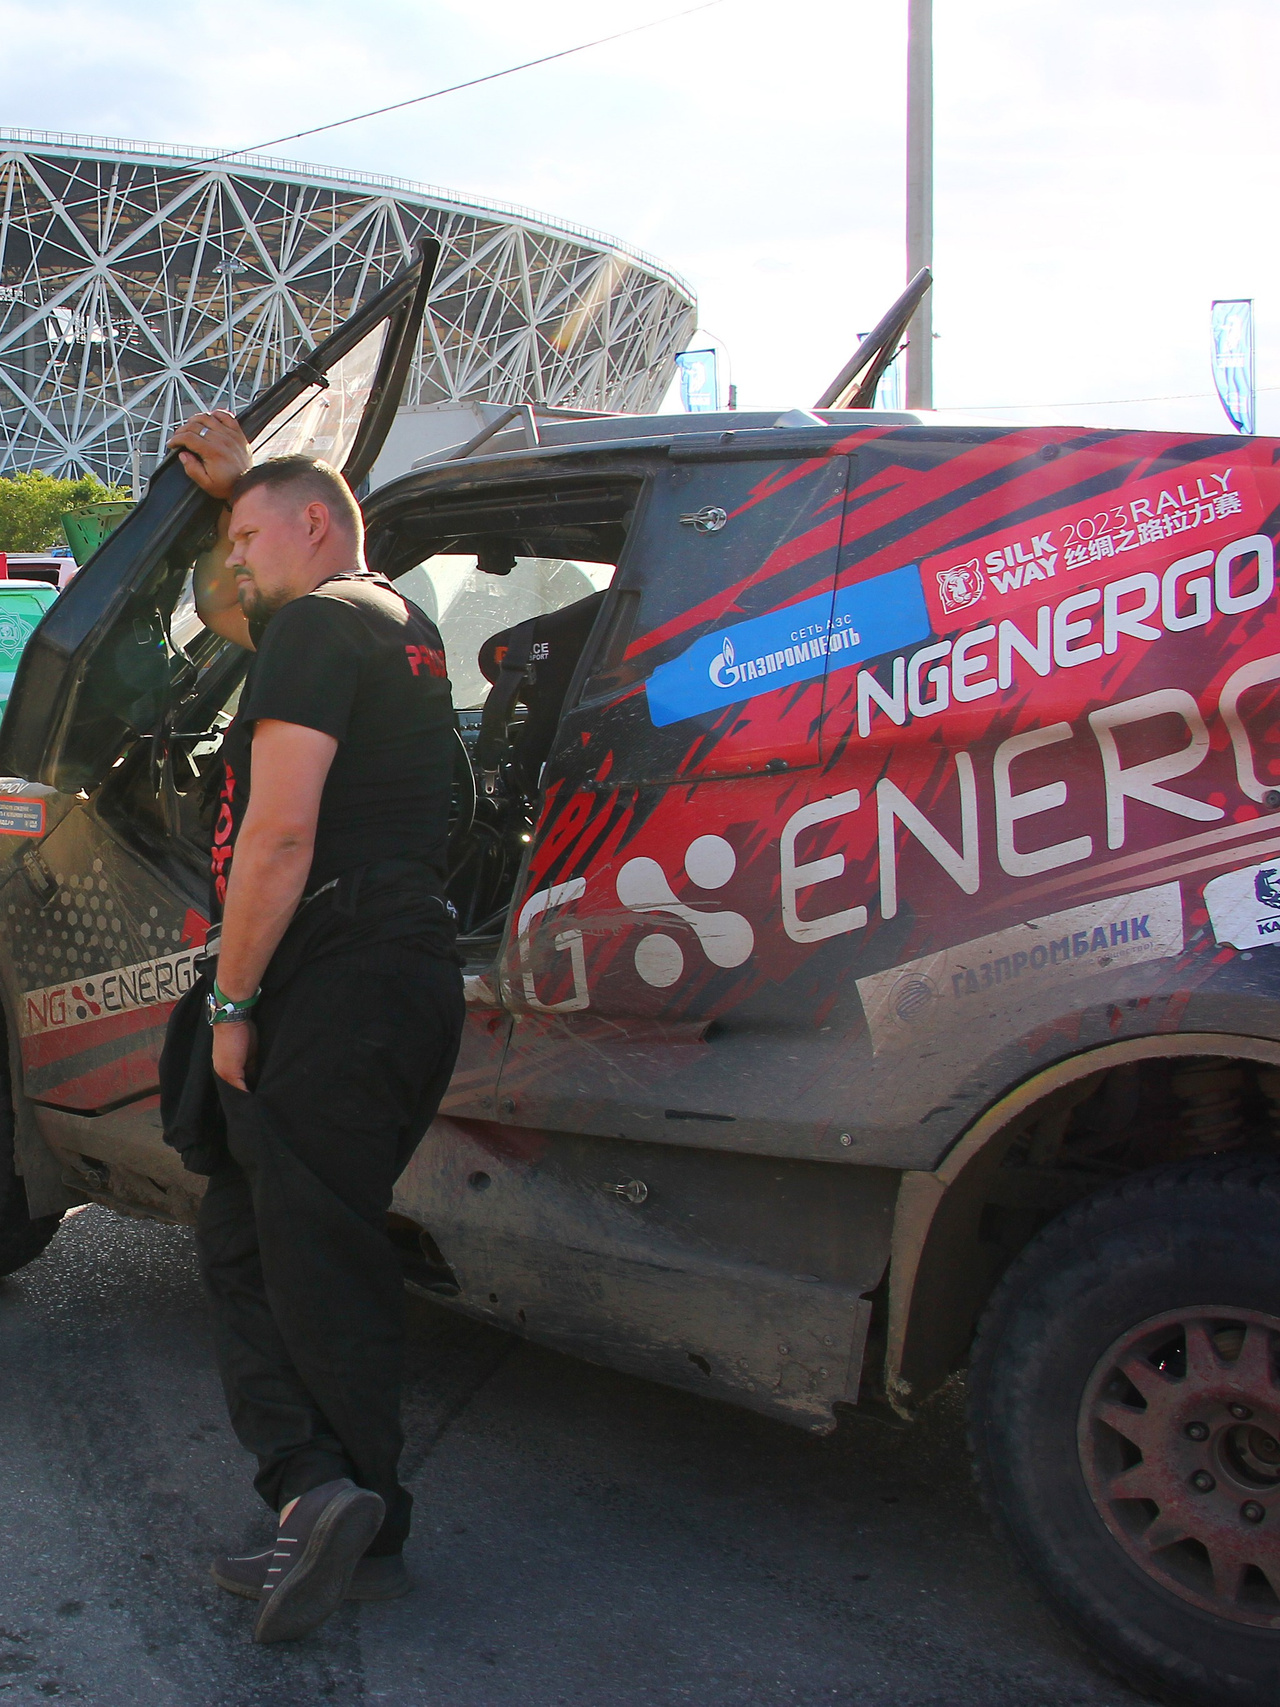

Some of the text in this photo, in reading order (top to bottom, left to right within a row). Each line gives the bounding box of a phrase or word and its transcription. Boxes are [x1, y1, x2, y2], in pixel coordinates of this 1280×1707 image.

[1060, 469, 1232, 547] 2023 RALLY
[1063, 490, 1242, 571] 丝绸之路拉力赛
[984, 531, 1057, 574] SILK
[988, 554, 1058, 595] WAY
[739, 627, 862, 683] ГАЗПРОМНЕФТЬ
[790, 614, 852, 642] СЕТЬ АЗС
[856, 533, 1274, 739] NGENERGO
[517, 876, 591, 1013] G
[950, 914, 1152, 999] ГАЗПРОМБАНК
[27, 989, 66, 1029] NG
